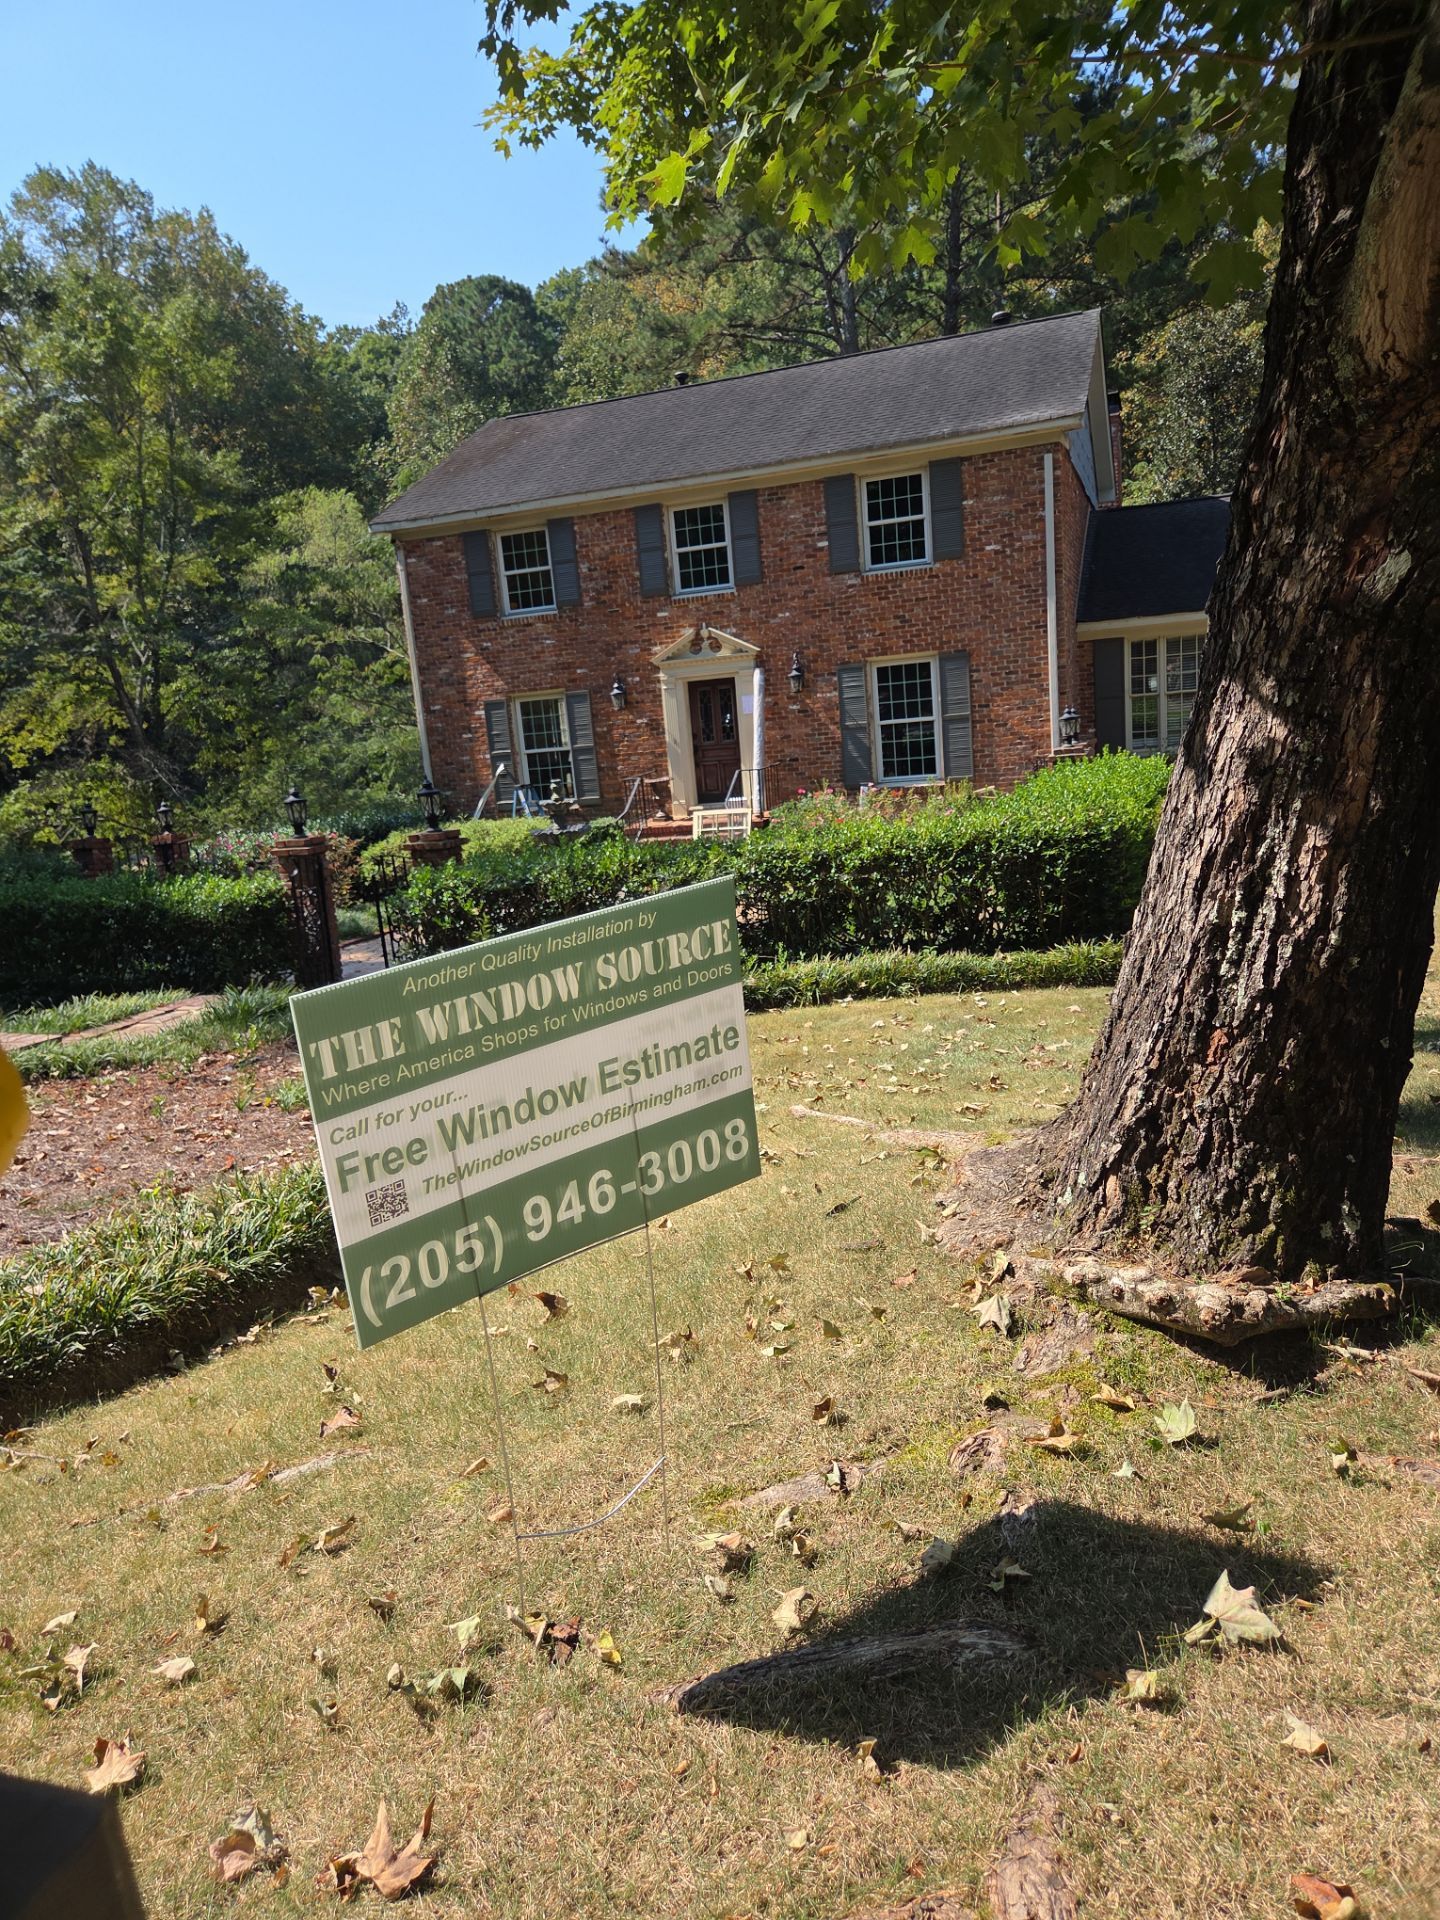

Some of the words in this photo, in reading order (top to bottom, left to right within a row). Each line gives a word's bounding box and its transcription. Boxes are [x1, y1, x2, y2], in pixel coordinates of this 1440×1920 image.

[309, 1016, 406, 1080] THE
[415, 961, 584, 1045] WINDOW
[596, 918, 733, 991] SOURCE
[402, 961, 477, 996] Another
[481, 943, 542, 972] Quality
[547, 917, 634, 954] Installation
[638, 911, 658, 929] by
[321, 1073, 391, 1106] Where
[396, 1044, 475, 1082] America
[481, 1024, 539, 1052] Shops
[543, 1013, 568, 1033] for
[571, 988, 648, 1023] Windows
[653, 976, 682, 998] and
[687, 963, 733, 987] Doors
[329, 1117, 369, 1145] Call
[374, 1108, 405, 1130] for
[409, 1090, 469, 1122] your...
[335, 1137, 428, 1194] Free
[436, 1076, 587, 1152] Window
[598, 1024, 740, 1095] Estimate
[422, 1064, 743, 1194] TheWindowSourceOfBirmingham.com
[360, 1215, 504, 1328] (205)
[522, 1118, 749, 1242] 946-3008
